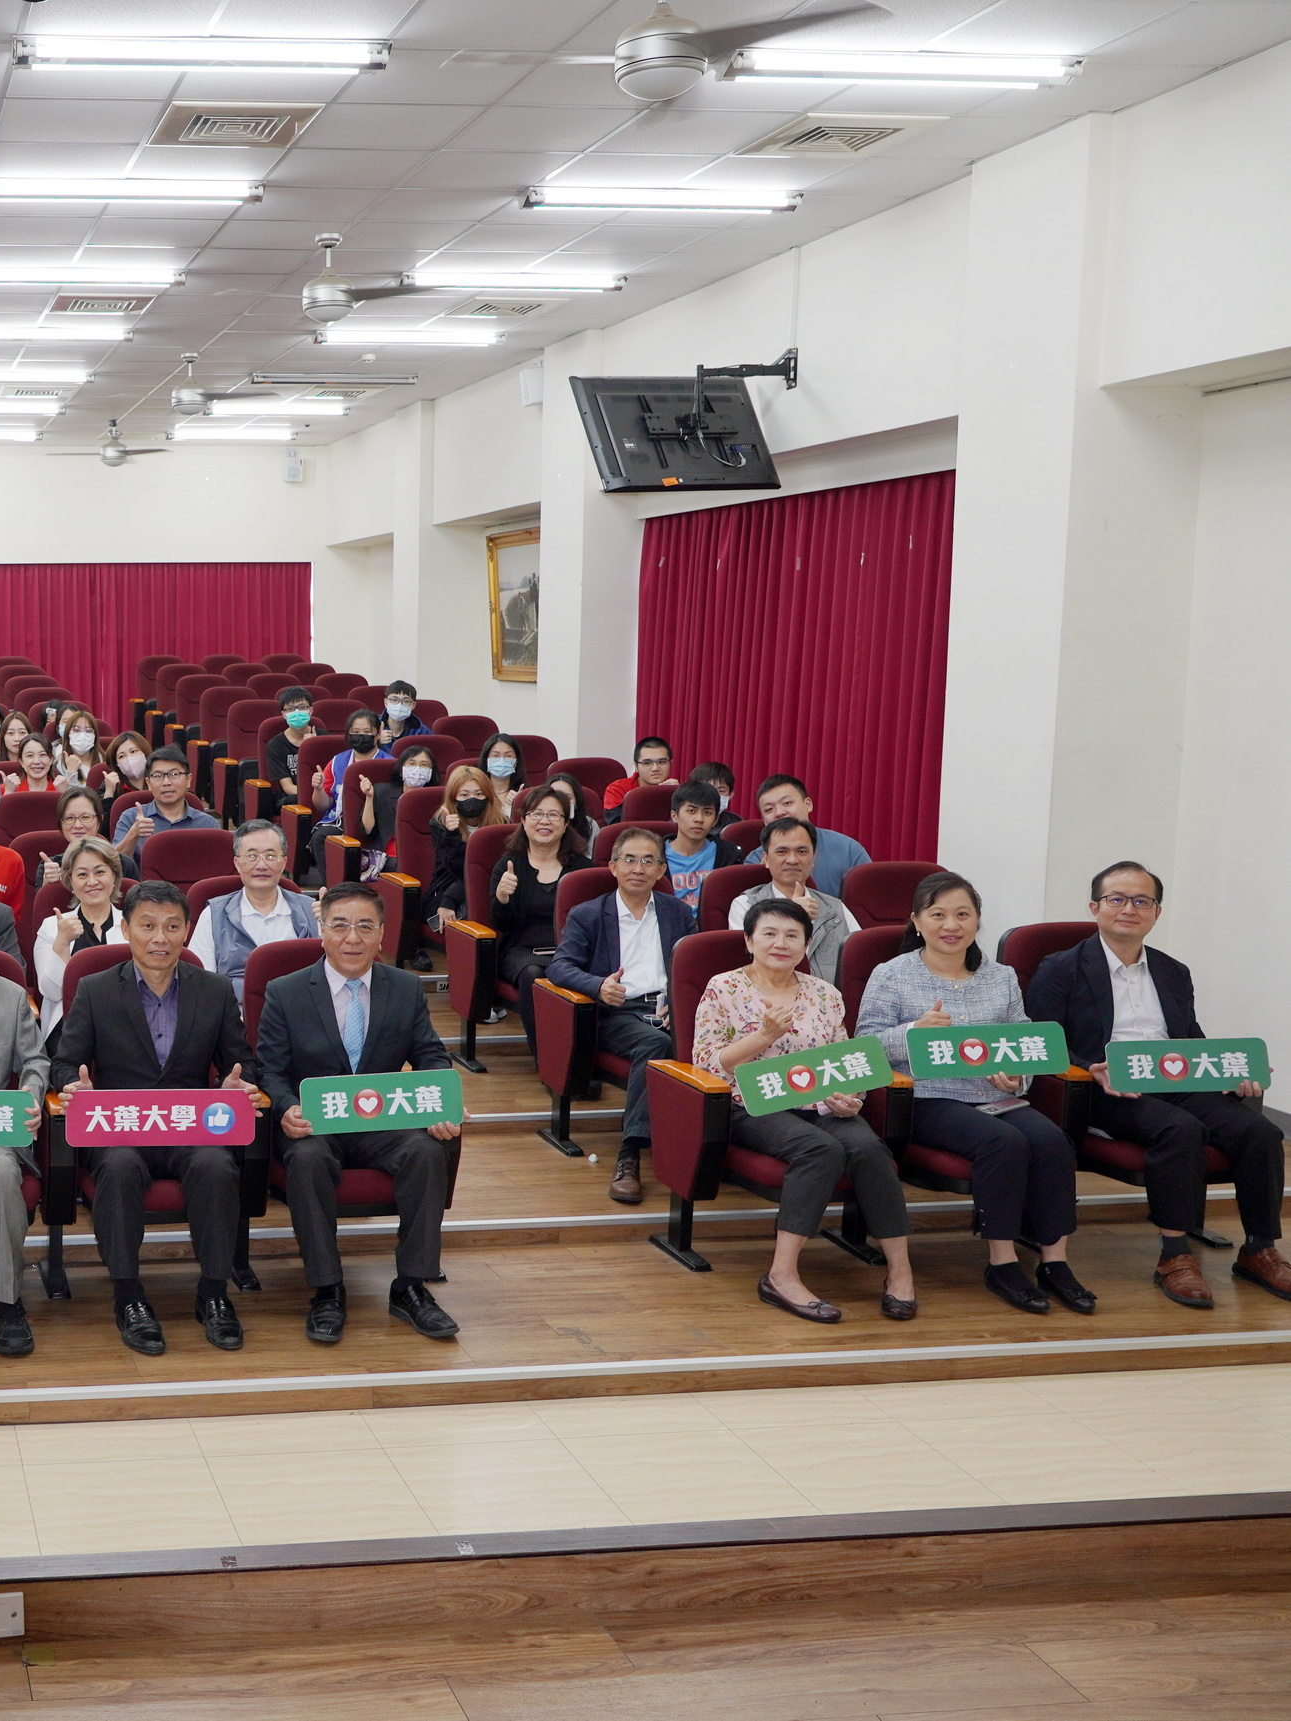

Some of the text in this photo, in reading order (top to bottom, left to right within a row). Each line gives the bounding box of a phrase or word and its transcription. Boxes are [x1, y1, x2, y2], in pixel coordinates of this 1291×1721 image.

[928, 1036, 1049, 1065] 我 大葉
[757, 1051, 873, 1100] 我 大葉
[1127, 1052, 1250, 1080] 我 大葉
[322, 1086, 443, 1119] 我 大葉
[85, 1104, 197, 1132] 大葉大學
